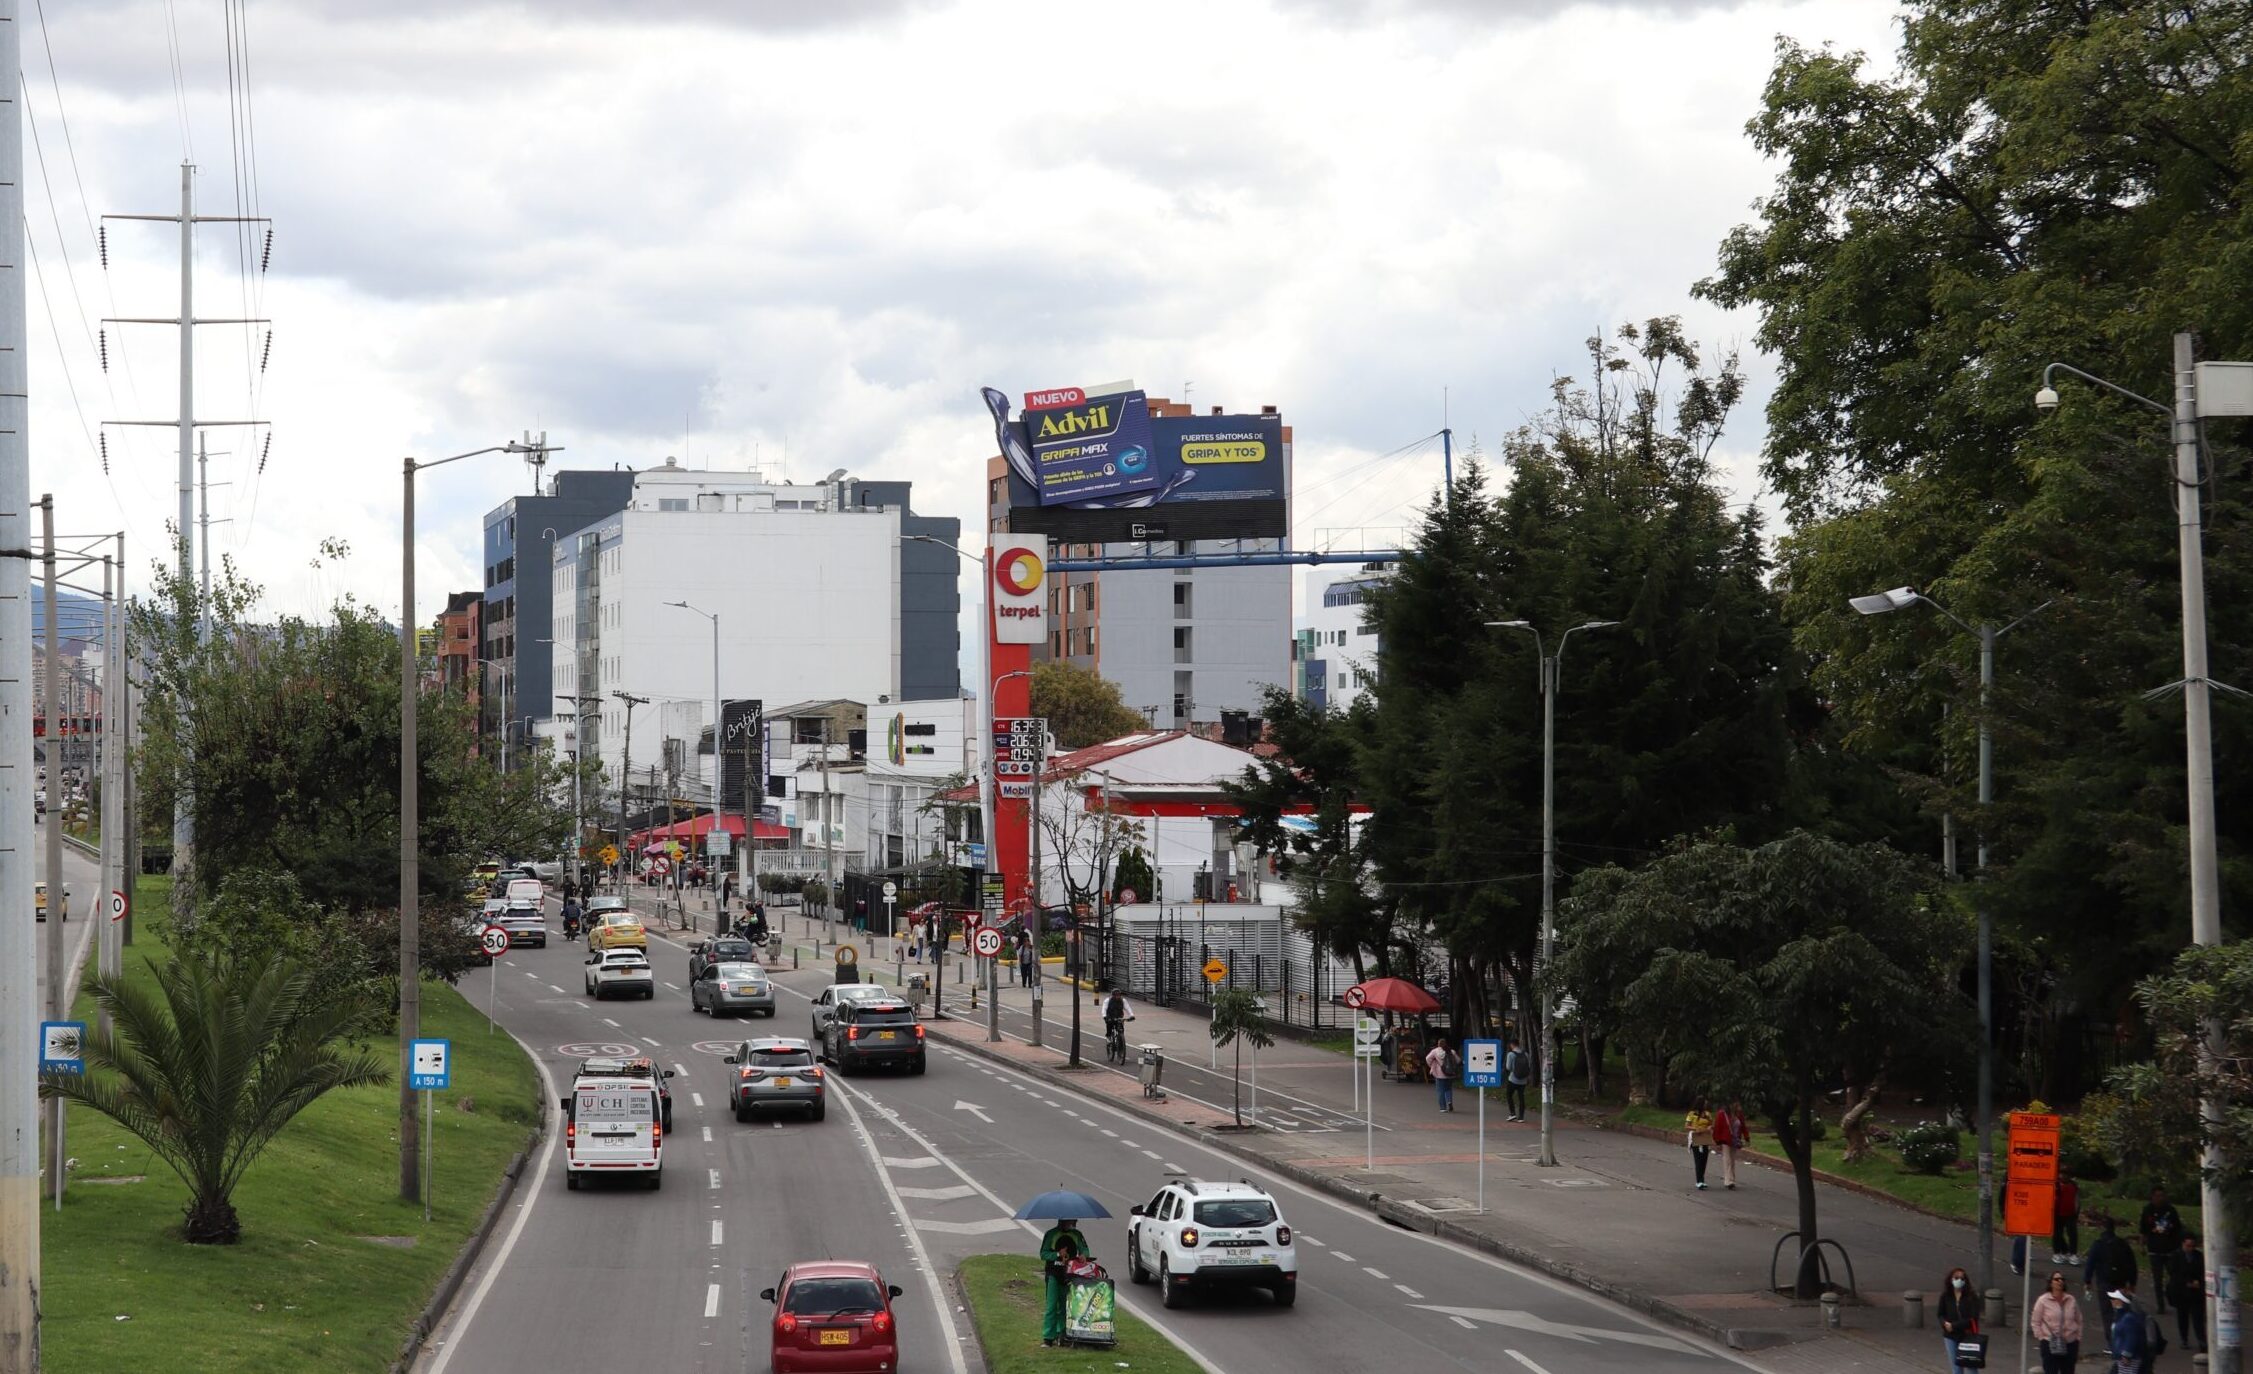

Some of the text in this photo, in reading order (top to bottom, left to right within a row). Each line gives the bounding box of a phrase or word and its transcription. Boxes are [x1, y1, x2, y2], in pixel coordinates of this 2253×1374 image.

[1033, 391, 1077, 405] NUEVO
[1038, 405, 1108, 437] Advil
[1181, 433, 1214, 442] FUERTES
[1215, 432, 1253, 441] SÍNTOMAS
[1041, 447, 1080, 462] GRIPA
[1082, 443, 1108, 455] MAX
[1187, 447, 1257, 459] GRIPA Y TOS
[1000, 604, 1041, 620] terpel
[486, 934, 505, 948] 50
[980, 935, 998, 949] 50
[571, 1045, 622, 1055] 50
[416, 1077, 444, 1086] A 150 m
[1470, 1075, 1475, 1083] A
[1477, 1075, 1488, 1083] 150
